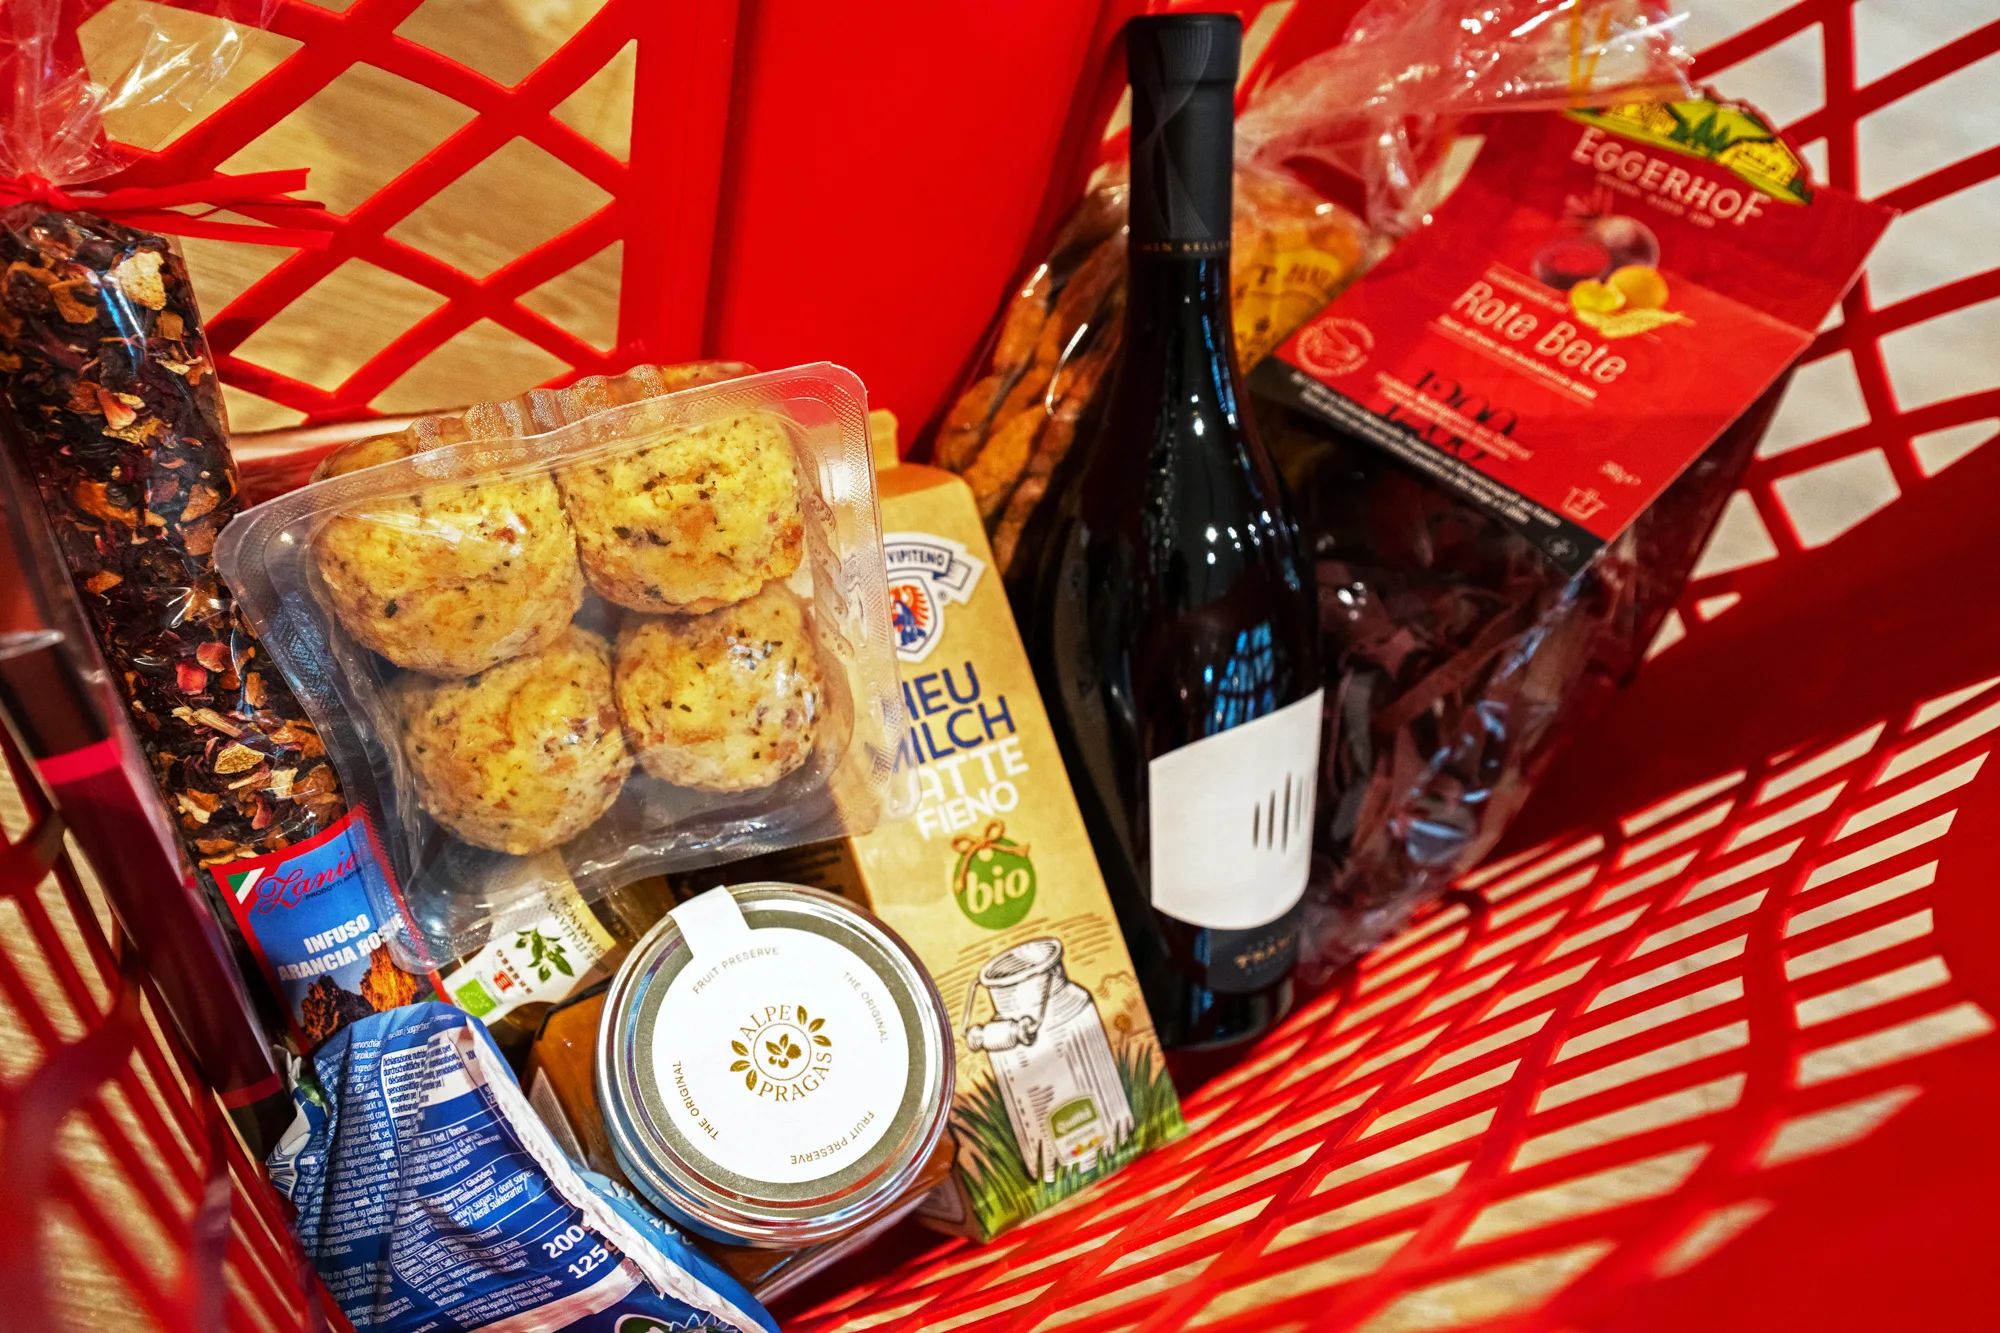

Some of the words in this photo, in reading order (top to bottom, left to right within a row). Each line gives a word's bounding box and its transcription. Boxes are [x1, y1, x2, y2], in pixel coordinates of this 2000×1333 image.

[1571, 126, 1772, 225] EGGERHOF
[915, 780, 1020, 840] FIENO
[305, 879, 343, 901] PRODOTTI
[966, 865, 1030, 914] bio
[303, 914, 371, 956] INFUSO
[276, 948, 358, 982] ARANCIA
[692, 967, 720, 994] FRUIT
[722, 946, 779, 969] PRESERVE
[739, 1004, 791, 1042] ALPE
[843, 971, 861, 991] THE
[861, 992, 888, 1044] ORIGINAL
[672, 1060, 700, 1117] ORIGINAL
[757, 1052, 832, 1102] PRAGAS
[370, 1120, 389, 1131] packed
[448, 1126, 468, 1136] Rasva
[465, 1134, 482, 1143] which
[700, 1118, 719, 1141] THE
[849, 1110, 875, 1140] FRUIT
[452, 1160, 470, 1172] josta
[461, 1145, 473, 1155] fett
[790, 1136, 848, 1165] PRESERVE
[360, 1163, 388, 1174] Tillverkad
[466, 1170, 493, 1187] Glucides
[453, 1206, 474, 1221] which
[473, 1194, 496, 1210] sugars
[498, 1180, 514, 1193] dont
[472, 1205, 490, 1220] heraf
[488, 1184, 523, 1210] sukkerarter
[436, 1292, 464, 1306] Nettopaino
